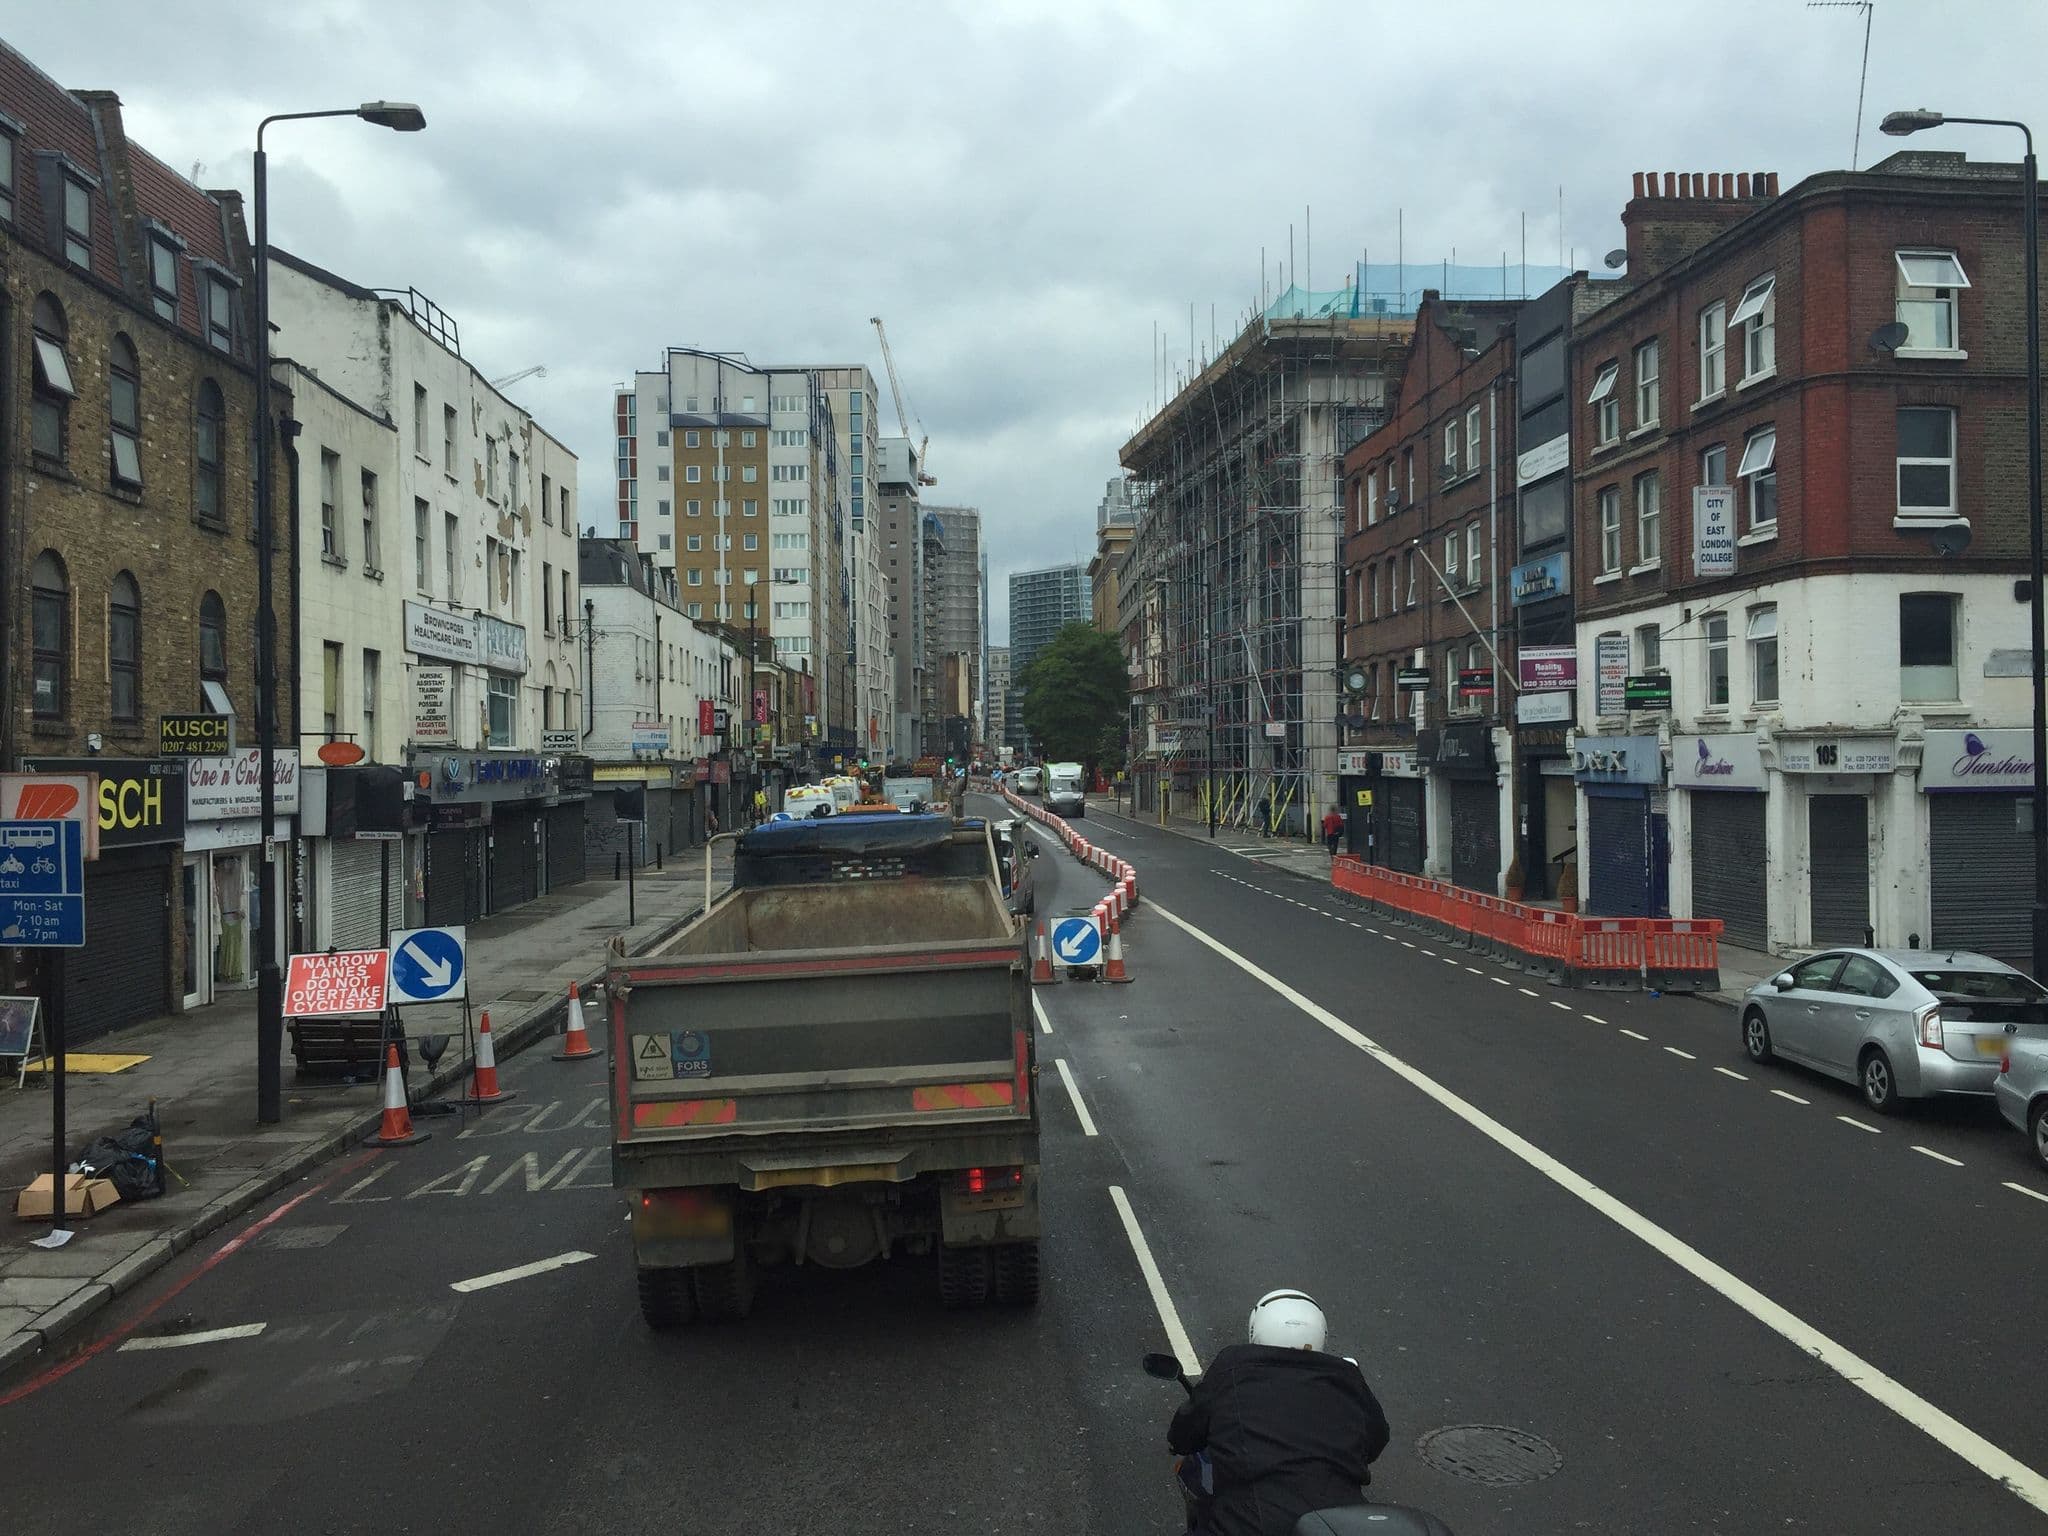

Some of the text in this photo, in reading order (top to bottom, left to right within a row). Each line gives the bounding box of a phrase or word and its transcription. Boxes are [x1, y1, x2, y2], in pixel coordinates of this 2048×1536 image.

[1707, 499, 1724, 508] CITY
[1711, 513, 1720, 521] OF
[1706, 526, 1725, 535] EAST
[1701, 540, 1732, 549] LONDON
[1701, 553, 1733, 563] COLLEGE
[423, 613, 464, 635] BROWNCROSS
[414, 625, 452, 645] HEALTHCARE
[452, 634, 473, 650] LIMITED
[162, 720, 228, 737] KUSCH
[543, 734, 576, 743] KDK
[162, 740, 228, 752] 0207 481 2299
[1816, 744, 1838, 765] 105
[1953, 752, 2034, 776] Sunshine
[190, 757, 218, 787] One
[273, 757, 295, 785] Ltd
[98, 778, 162, 830] SCH
[0, 879, 20, 889] taxi
[14, 900, 37, 911] Mon
[45, 900, 63, 911] Sat
[44, 917, 60, 926] am
[42, 931, 58, 941] pm
[303, 953, 378, 969] NARROW
[312, 965, 367, 979] LANES
[306, 976, 371, 990] DO NOT
[292, 985, 381, 1001] OVERTAKE
[294, 997, 377, 1013] CYCLISTS
[677, 1060, 708, 1071] FORS
